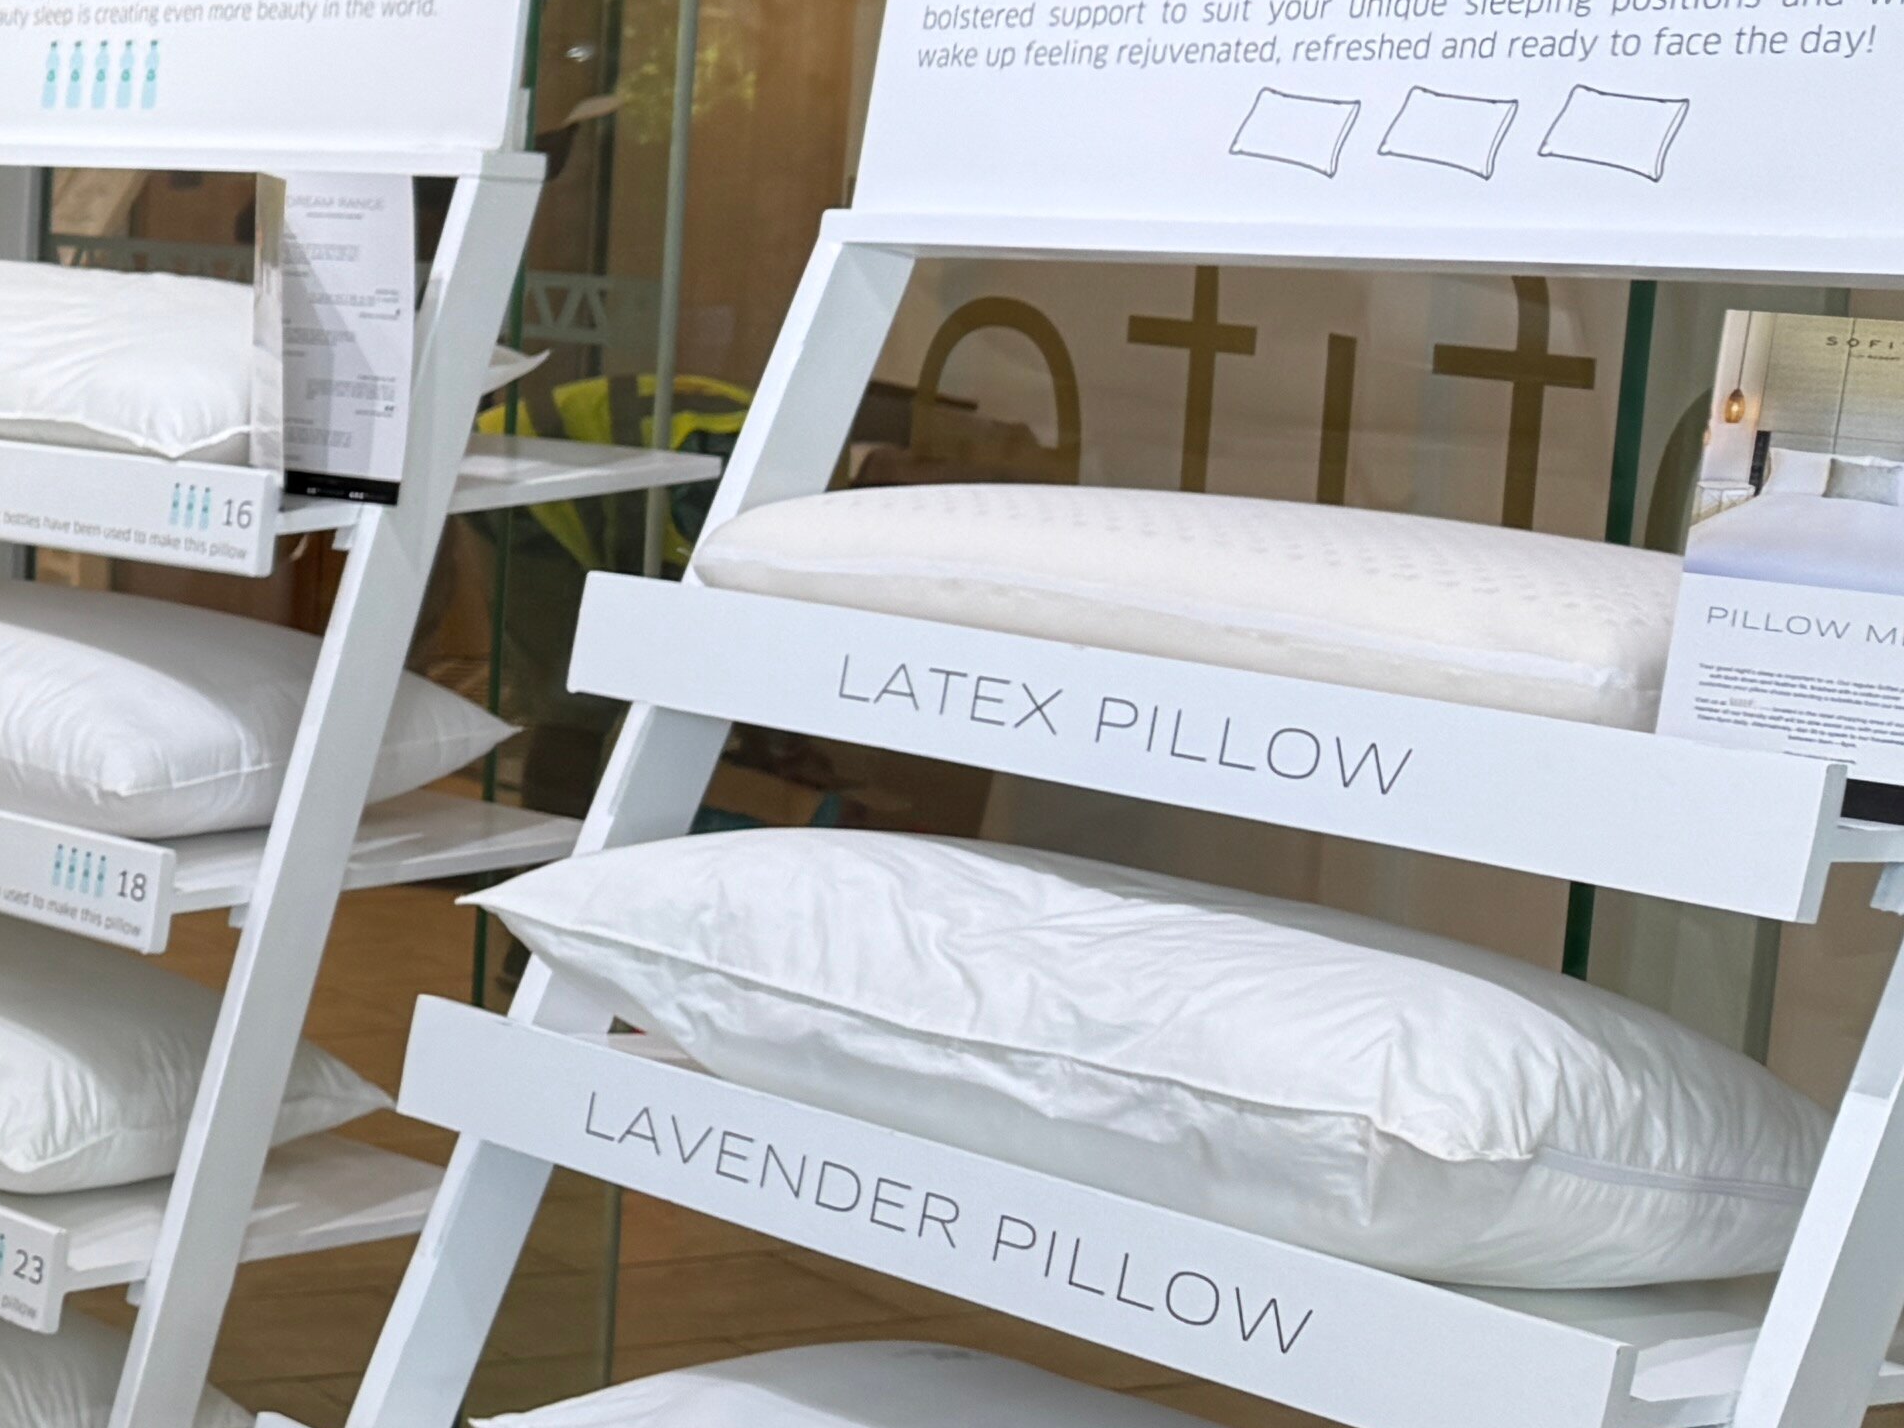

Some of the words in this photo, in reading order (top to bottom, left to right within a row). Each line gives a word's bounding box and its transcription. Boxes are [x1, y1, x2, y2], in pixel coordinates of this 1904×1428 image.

[33, 6, 73, 26] sleep
[94, 5, 159, 26] creating
[162, 4, 203, 23] even
[207, 2, 252, 21] more
[256, 0, 317, 22] beauty
[922, 2, 1035, 30] bolstered
[1048, 1, 1145, 29] support
[1161, 0, 1187, 24] to
[917, 43, 978, 68] wake
[985, 45, 1016, 70] up
[1024, 39, 1108, 69] feeling
[1116, 36, 1279, 67] rejuvenated,
[1292, 32, 1431, 61] refreshed
[1440, 30, 1497, 59] and
[1507, 28, 1598, 62] ready
[1609, 29, 1641, 57] to
[1653, 26, 1721, 56] face
[1734, 25, 1788, 55] the
[1799, 23, 1876, 58] day!
[1825, 334, 1904, 352] SOFI
[221, 497, 253, 530] 16
[1706, 605, 1852, 641] PILLOW
[837, 653, 1064, 737] LATEX
[1093, 695, 1414, 797] PILLOW
[115, 868, 149, 903] 18
[584, 1090, 961, 1250] LAVENDER
[991, 1213, 1315, 1356] PILLOW
[11, 1247, 45, 1287] 23
